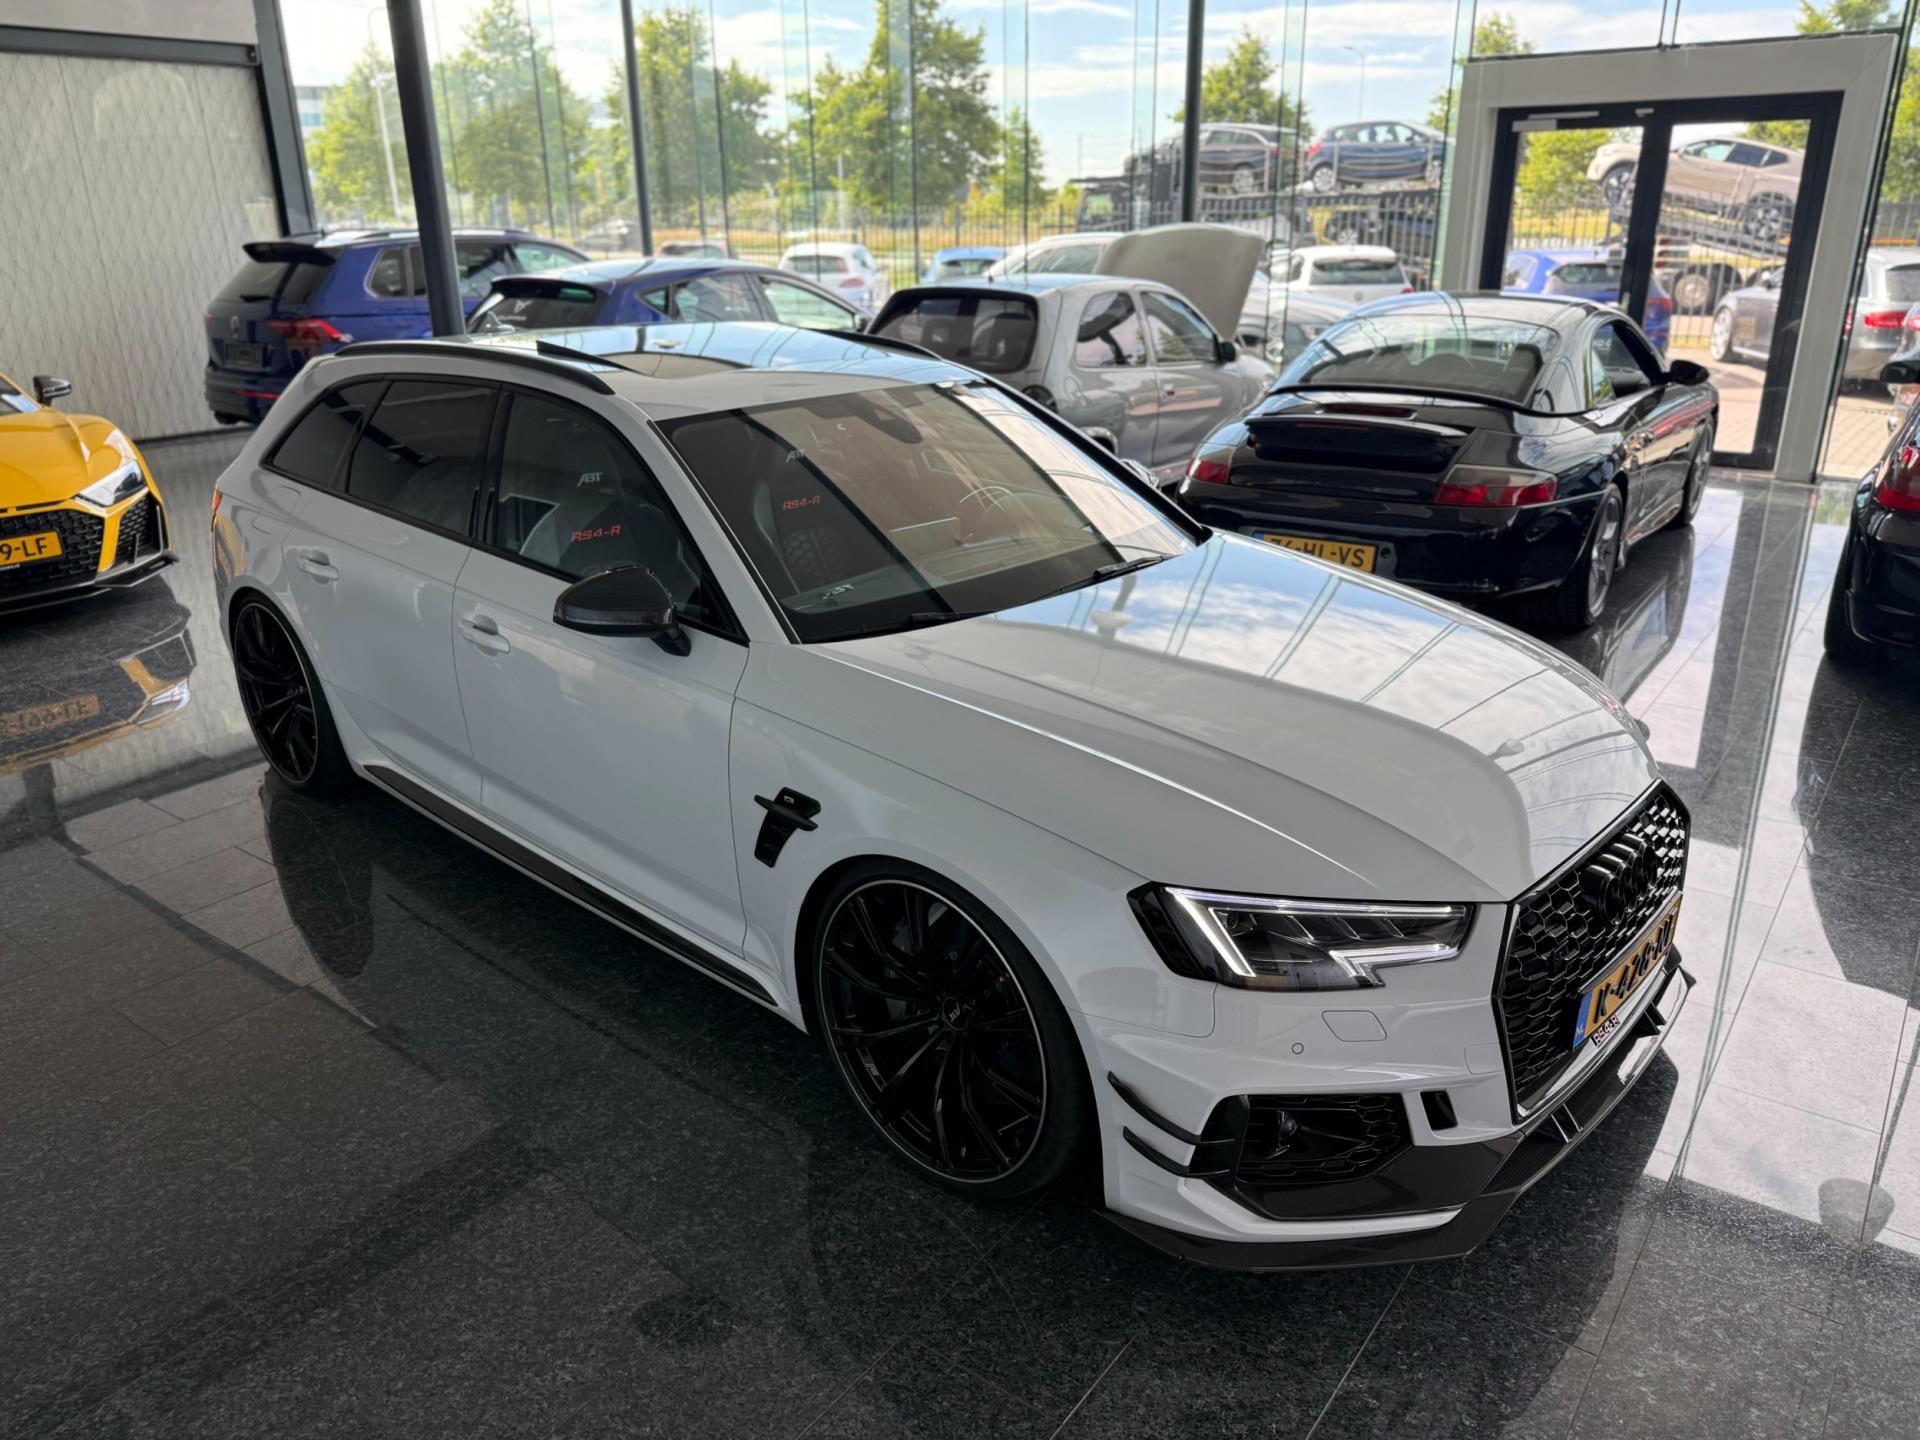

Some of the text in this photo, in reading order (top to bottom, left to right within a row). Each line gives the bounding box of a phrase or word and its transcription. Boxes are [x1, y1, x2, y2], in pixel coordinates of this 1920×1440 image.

[576, 472, 602, 488] ABT
[783, 495, 821, 511] RS4-R
[571, 524, 622, 543] RS4-R
